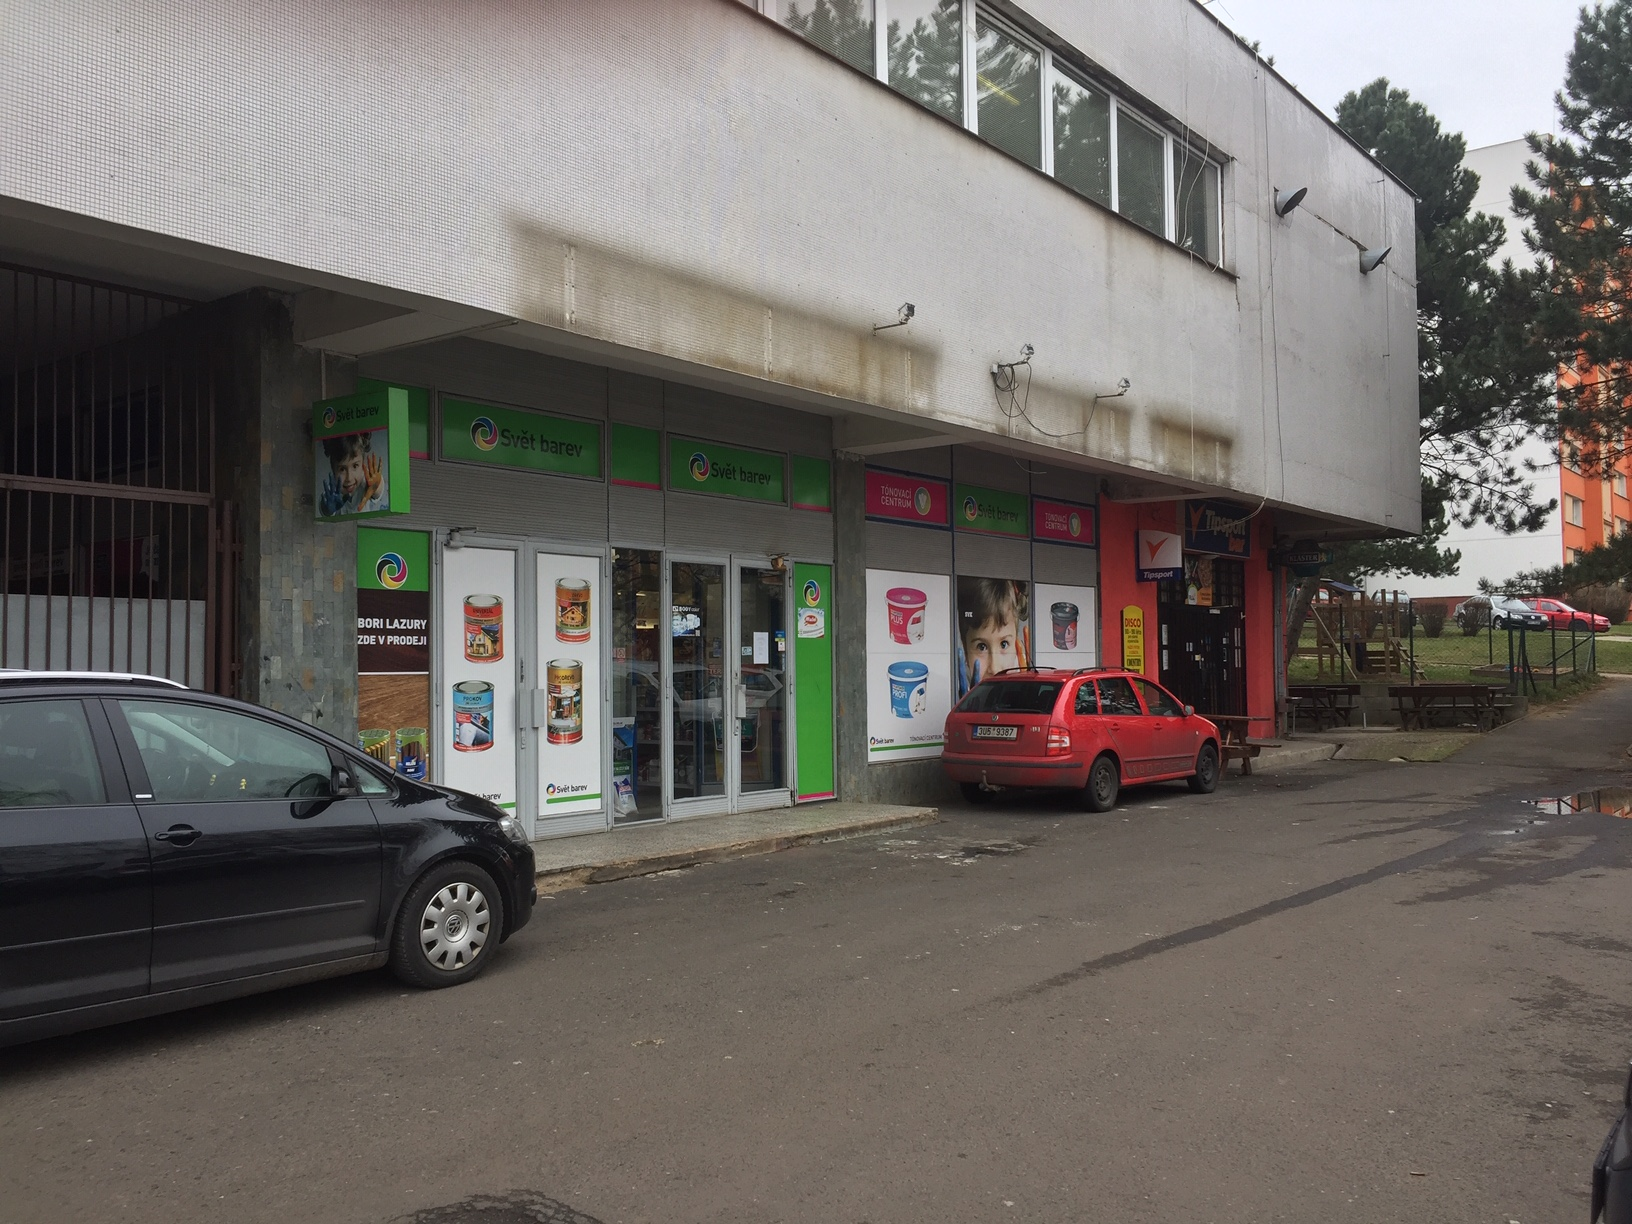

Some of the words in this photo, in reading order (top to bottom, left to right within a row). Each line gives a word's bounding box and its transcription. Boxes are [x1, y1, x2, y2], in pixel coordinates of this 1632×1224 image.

[336, 406, 354, 422] Svět
[355, 404, 380, 420] barev
[500, 427, 536, 451] Svět
[540, 434, 583, 458] barev
[711, 462, 737, 480] Svět
[740, 466, 771, 485] barev
[880, 484, 912, 499] TÓNOVACÍ
[880, 495, 912, 509] CENTRUM
[978, 503, 995, 519] Svět
[997, 506, 1018, 523] barev
[1205, 509, 1246, 538] Tipsport
[1228, 536, 1246, 553] bar
[1143, 570, 1174, 580] Tipsport
[357, 617, 384, 629] BORI
[386, 618, 427, 630] LAZURY
[1124, 618, 1141, 628] DISCO
[357, 635, 377, 645] ZDE
[378, 635, 386, 645] V
[387, 635, 427, 646] PRODEJI
[978, 727, 992, 736] 3U5
[996, 727, 1014, 737] 9387
[556, 783, 570, 794] Svět
[571, 783, 588, 793] barev
